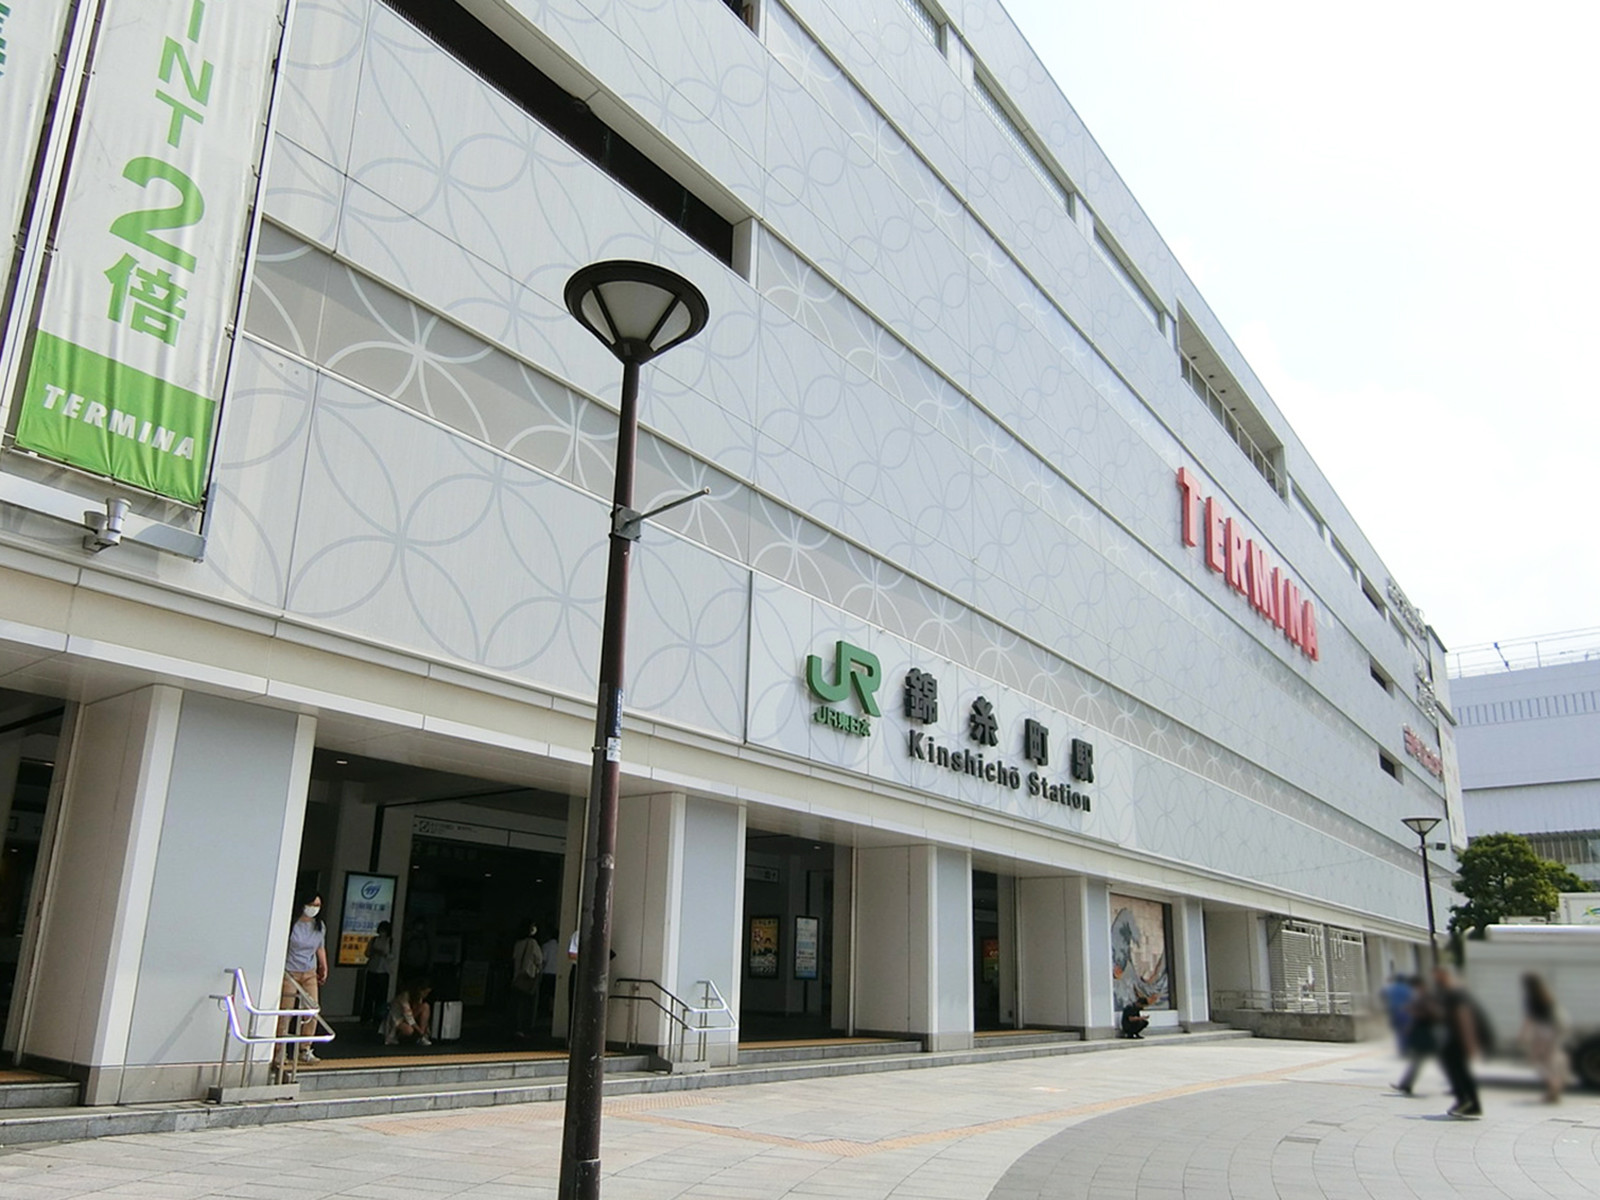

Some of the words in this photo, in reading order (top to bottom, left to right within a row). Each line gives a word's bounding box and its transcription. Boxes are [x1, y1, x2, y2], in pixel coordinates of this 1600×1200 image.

[43, 385, 195, 461] TERMINA
[1176, 467, 1319, 662] TERMINA
[807, 641, 881, 717] JR
[906, 668, 1094, 783] 錦糸町駅
[1027, 772, 1091, 812] Station
